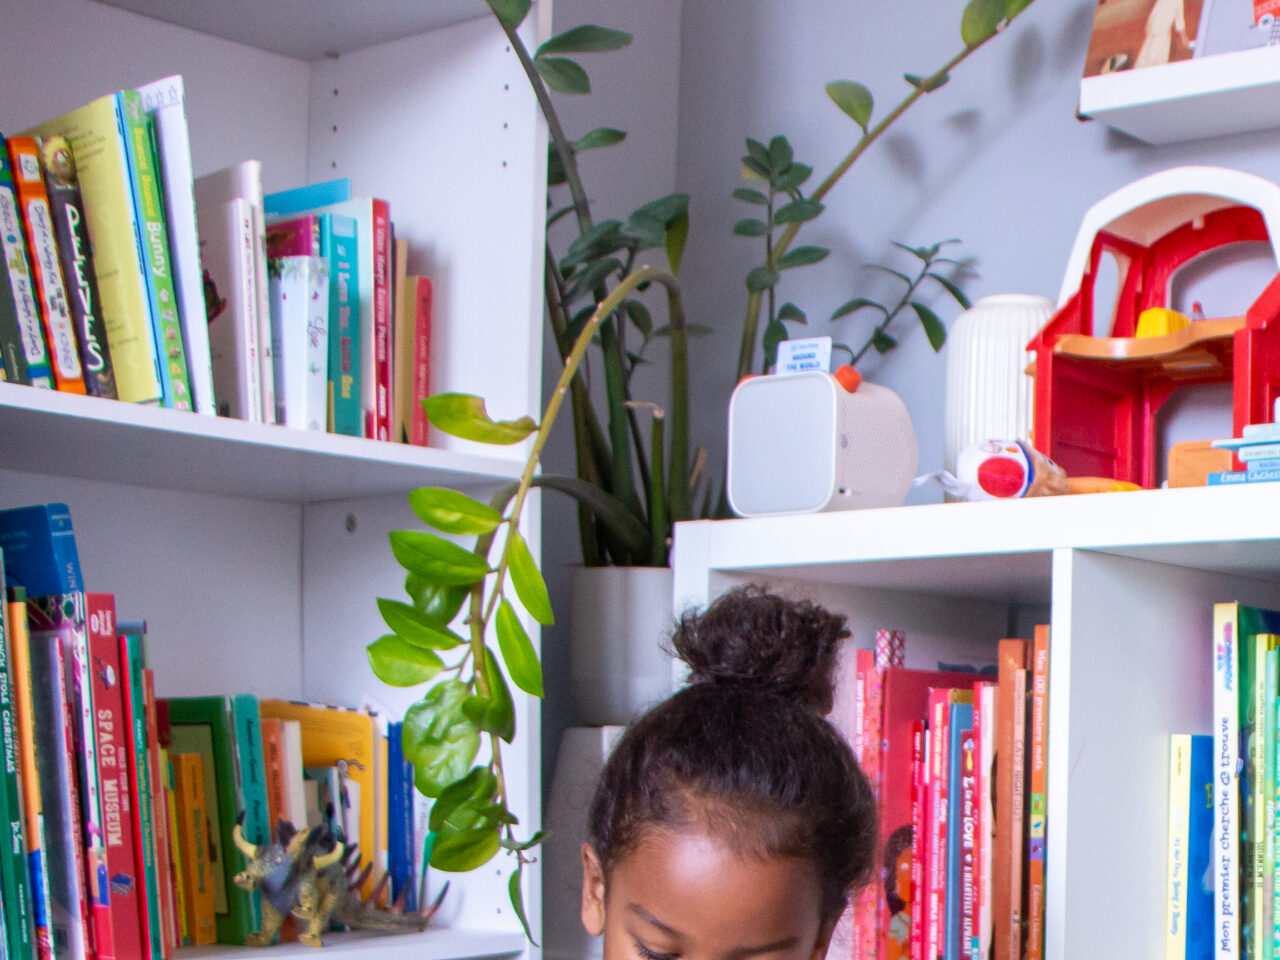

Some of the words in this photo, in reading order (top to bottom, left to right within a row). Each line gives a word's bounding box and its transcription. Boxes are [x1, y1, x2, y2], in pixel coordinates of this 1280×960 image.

[146, 221, 168, 279] Bunny
[1220, 472, 1246, 483] Emma
[1035, 674, 1046, 695] 100
[1036, 649, 1047, 671] Mes
[1, 709, 16, 773] CHRISTMAS
[98, 708, 118, 767] SPACE
[1032, 697, 1046, 741] premiers
[1219, 716, 1231, 768] trouve
[104, 778, 123, 847] MUSEUM
[963, 816, 975, 849] LOVE
[1219, 788, 1231, 851] cherche
[1218, 855, 1234, 917] premier
[1220, 921, 1232, 954] Mon
